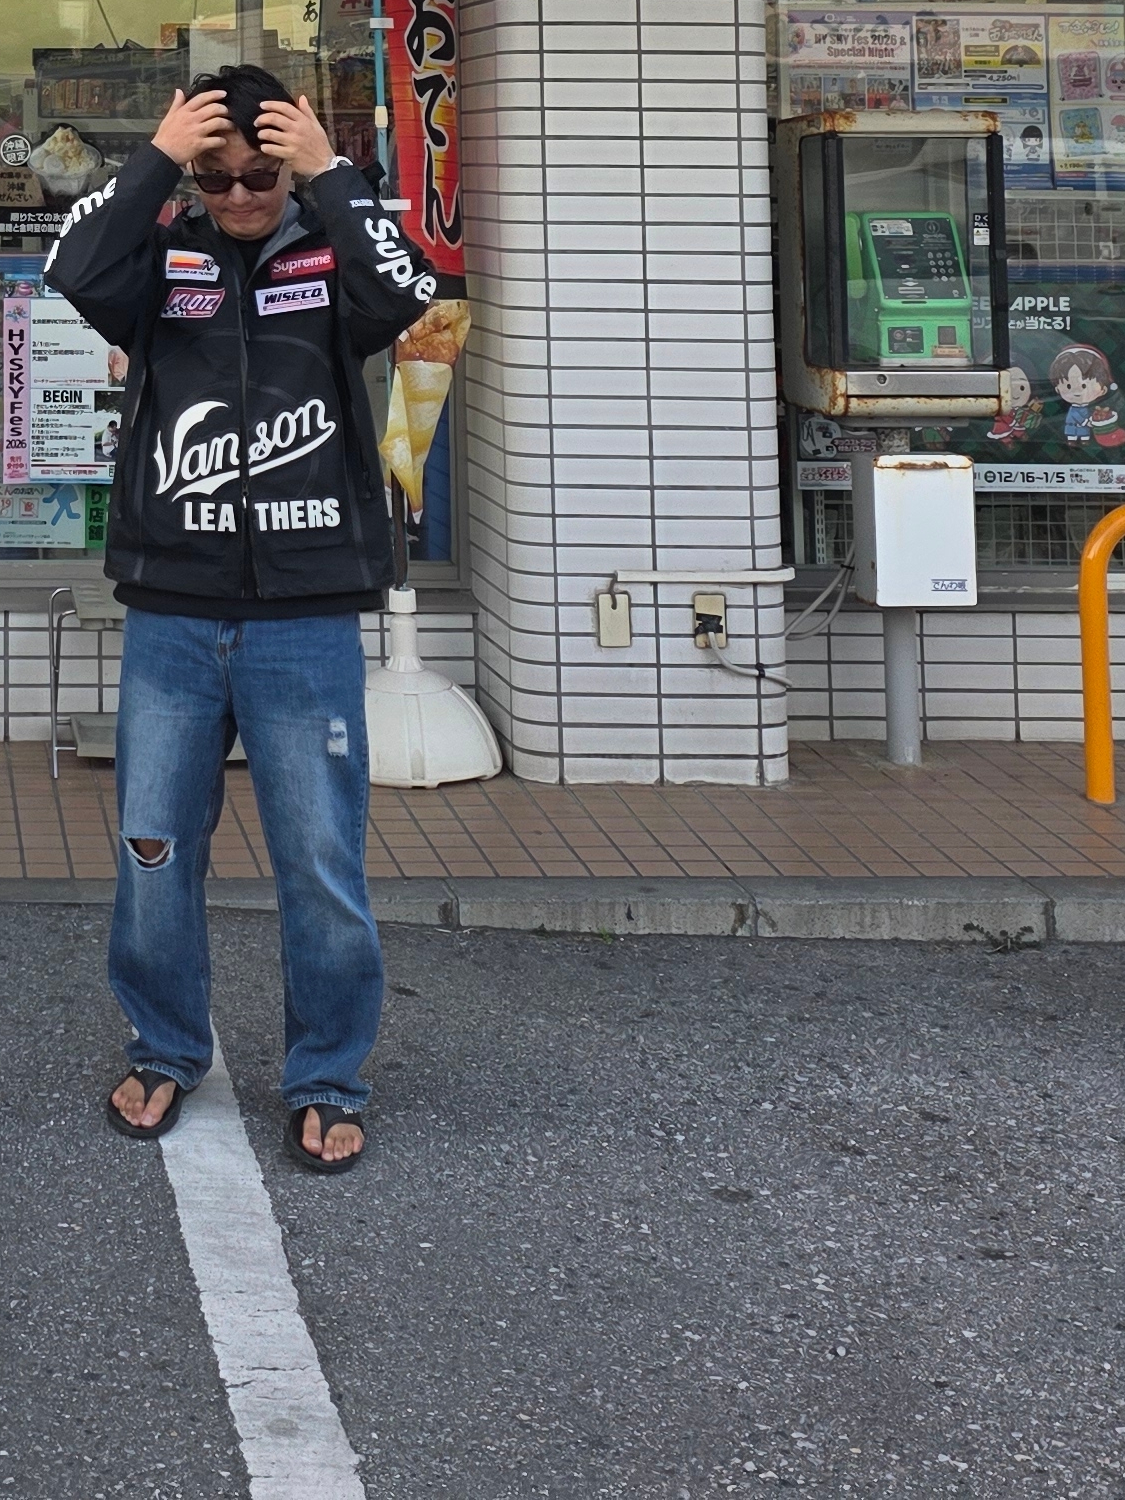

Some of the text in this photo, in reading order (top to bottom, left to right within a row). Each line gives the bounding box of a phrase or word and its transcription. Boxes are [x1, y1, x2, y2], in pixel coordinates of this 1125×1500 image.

[871, 34, 897, 45] 2026
[827, 46, 866, 57] Special
[273, 254, 332, 274] Supreme
[171, 294, 220, 310] KLOTZ
[264, 288, 323, 304] WISECO
[1009, 296, 1071, 311] APPLE
[43, 390, 82, 403] BEGIN
[6, 439, 27, 449] 2026
